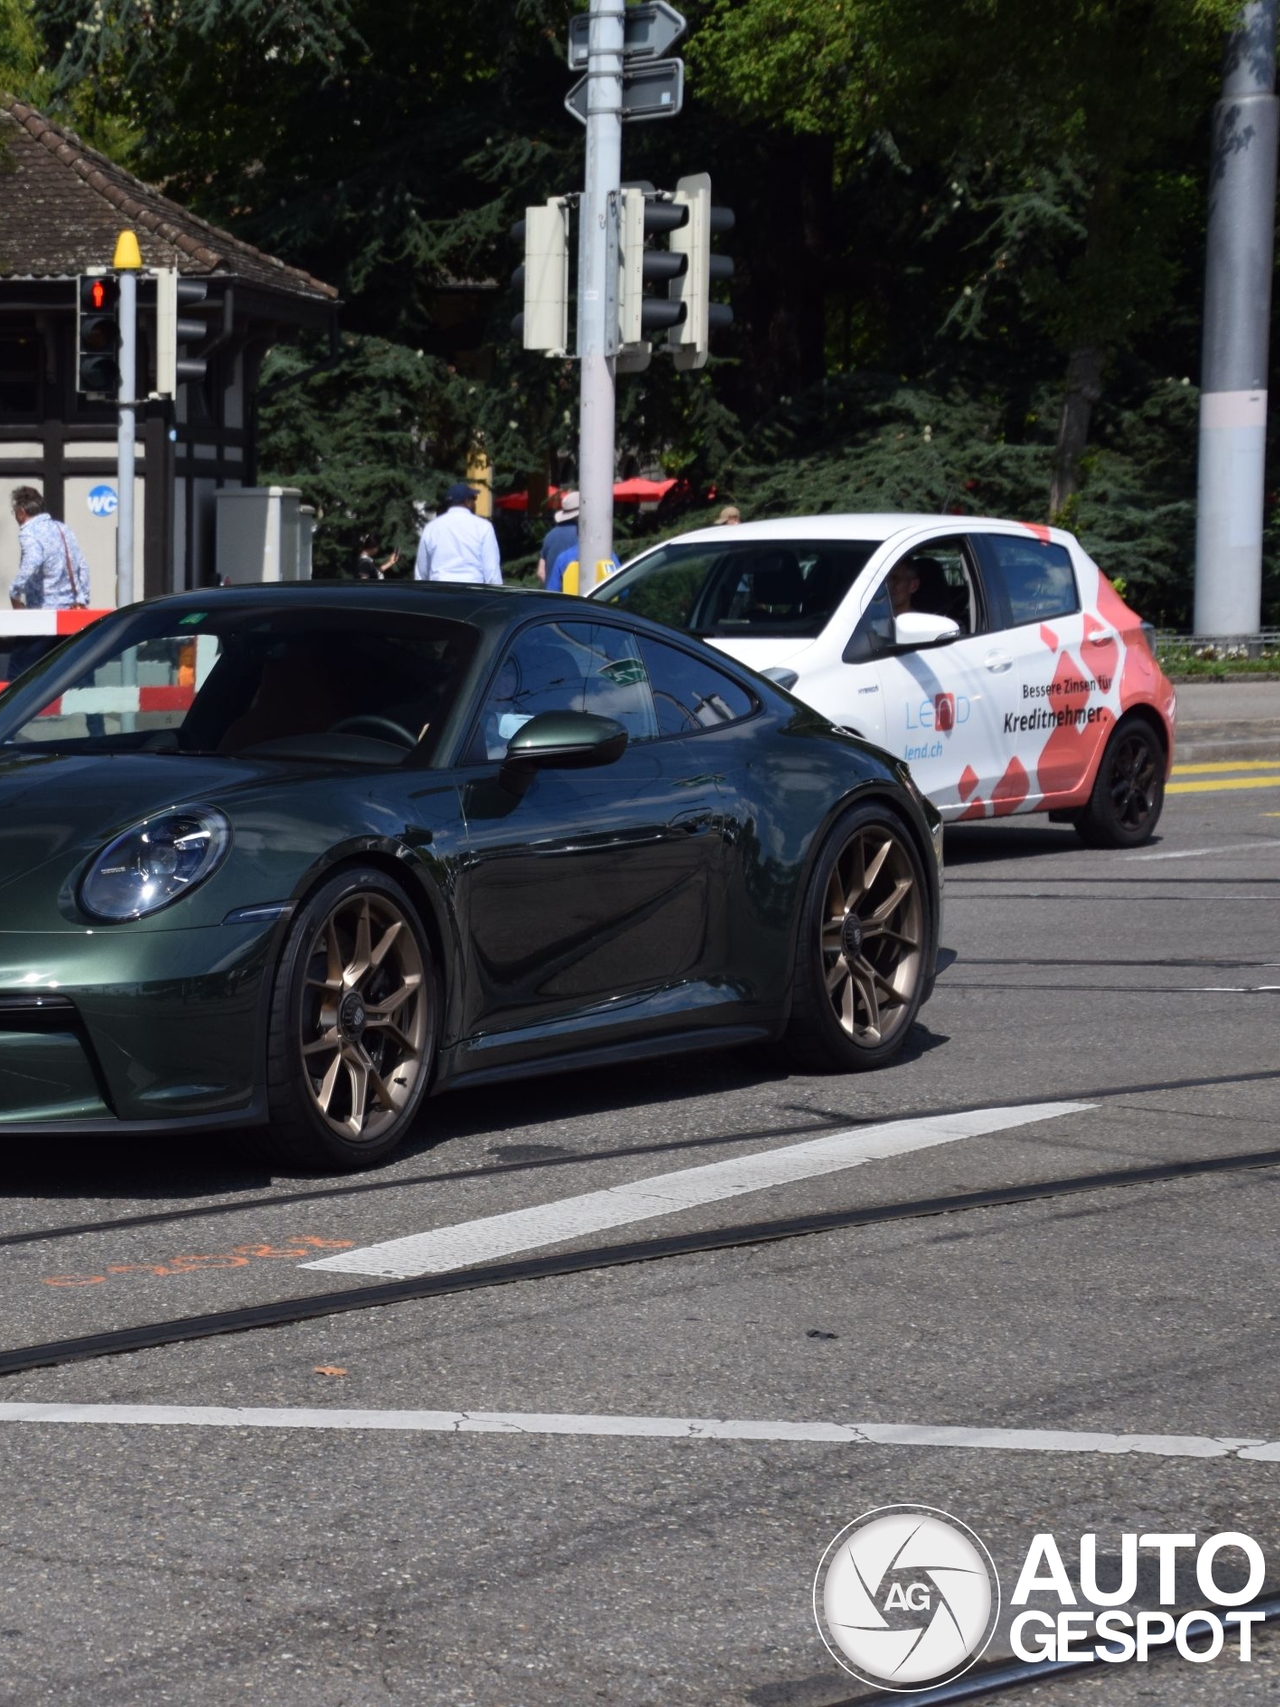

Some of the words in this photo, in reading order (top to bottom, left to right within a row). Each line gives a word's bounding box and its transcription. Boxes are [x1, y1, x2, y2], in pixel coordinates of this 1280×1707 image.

[87, 496, 118, 513] WC
[1023, 684, 1062, 699] Bessere
[1064, 678, 1096, 695] Zinsen
[1098, 675, 1113, 691] für
[1003, 704, 1108, 733] Kreditnehmer.
[904, 741, 943, 761] lend.ch
